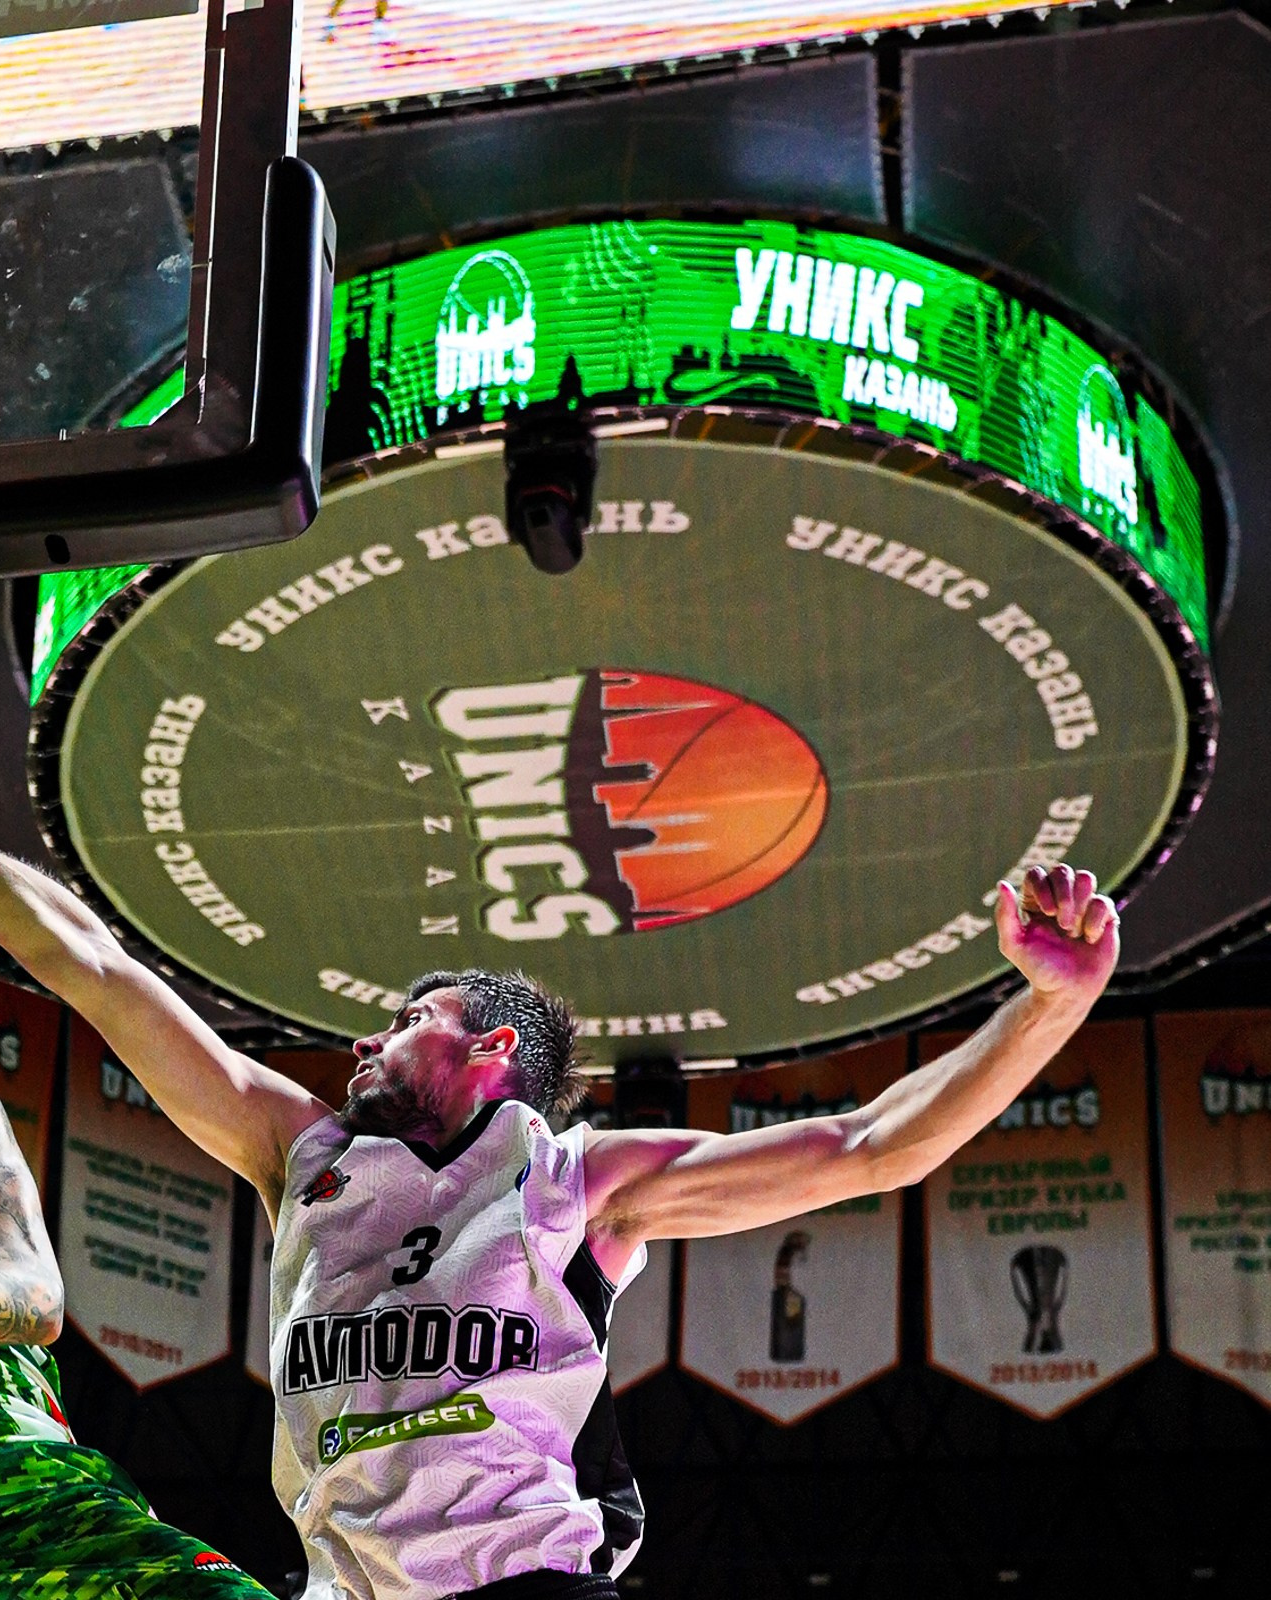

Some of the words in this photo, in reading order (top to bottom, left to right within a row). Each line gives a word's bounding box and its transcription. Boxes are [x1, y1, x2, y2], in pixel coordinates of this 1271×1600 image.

[730, 247, 924, 364] УНИКС
[841, 355, 958, 432] КАЗАНЬ
[435, 674, 622, 942] UNICS
[391, 1225, 442, 1286] 3
[283, 1303, 540, 1397] AVTODOR
